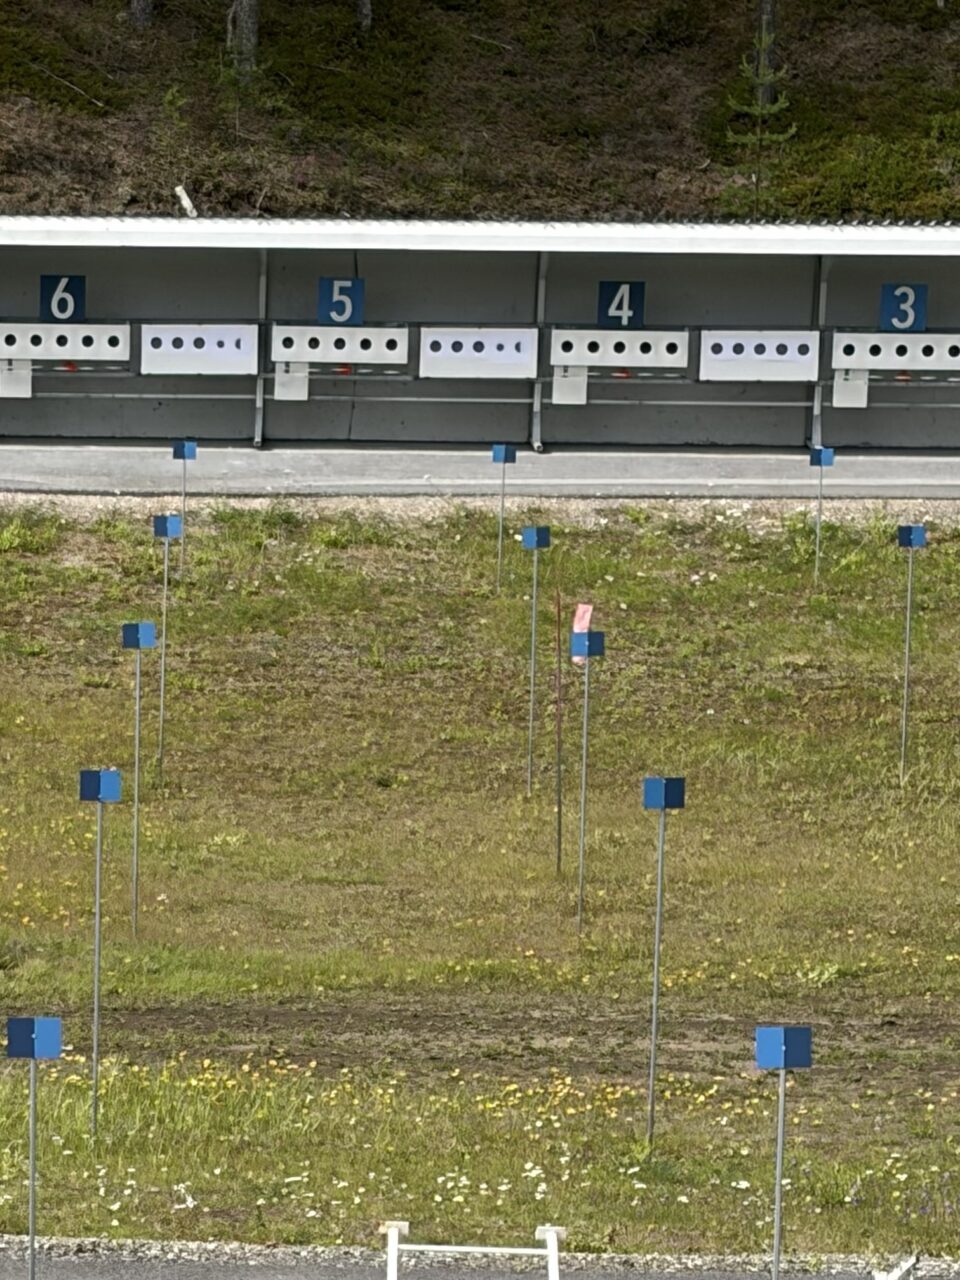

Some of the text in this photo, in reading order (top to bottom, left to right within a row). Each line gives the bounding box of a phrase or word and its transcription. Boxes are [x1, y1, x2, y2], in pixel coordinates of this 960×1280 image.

[50, 277, 75, 321] 6
[331, 280, 353, 323] 5
[607, 283, 634, 327] 4
[891, 285, 915, 329] 3
